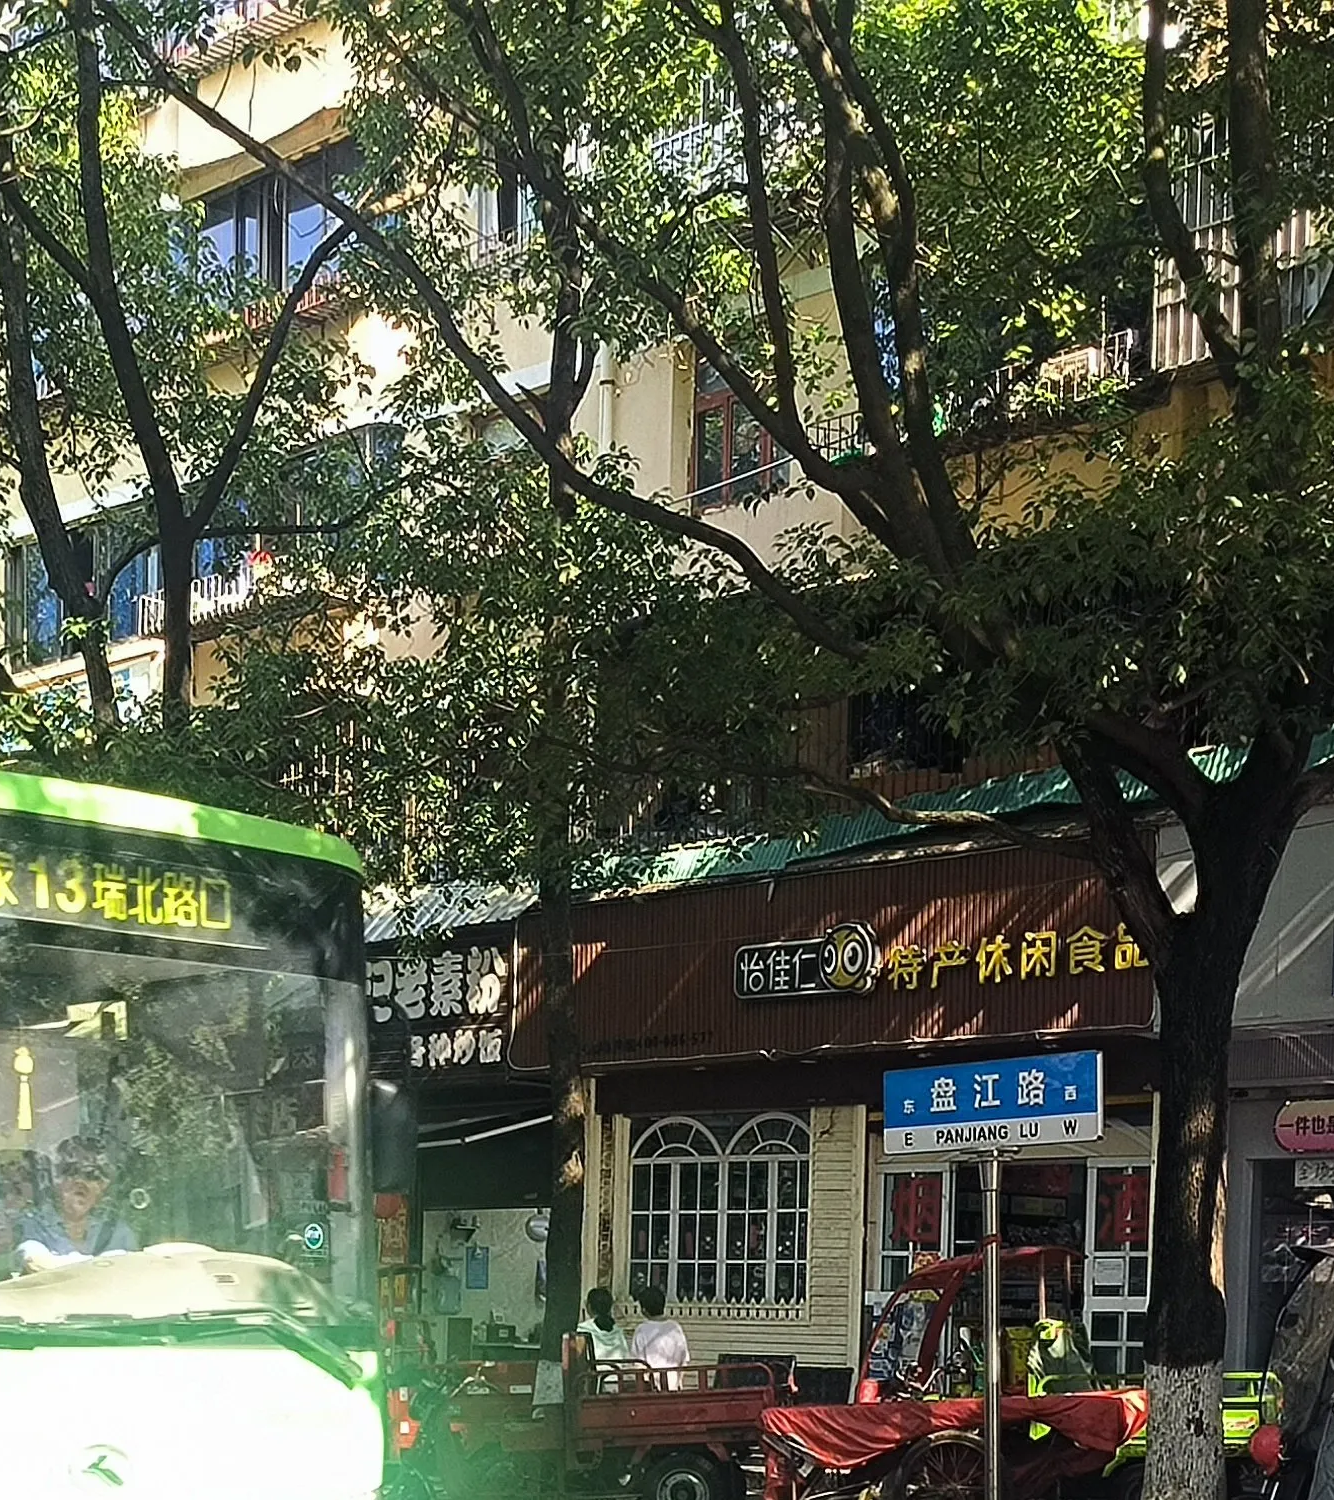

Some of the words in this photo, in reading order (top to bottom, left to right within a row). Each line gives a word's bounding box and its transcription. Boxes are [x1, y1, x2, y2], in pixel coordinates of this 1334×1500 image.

[29, 853, 88, 913] 13
[93, 861, 232, 930] 瑞北路口
[740, 947, 818, 993] 怡佳仁
[903, 1098, 915, 1115] 东
[929, 1068, 1047, 1113] 盘江路
[1063, 1085, 1078, 1102] 西
[904, 1132, 913, 1147] E
[935, 1124, 1009, 1144] PANJIANG
[1019, 1122, 1040, 1139] LU
[1063, 1119, 1078, 1136] W
